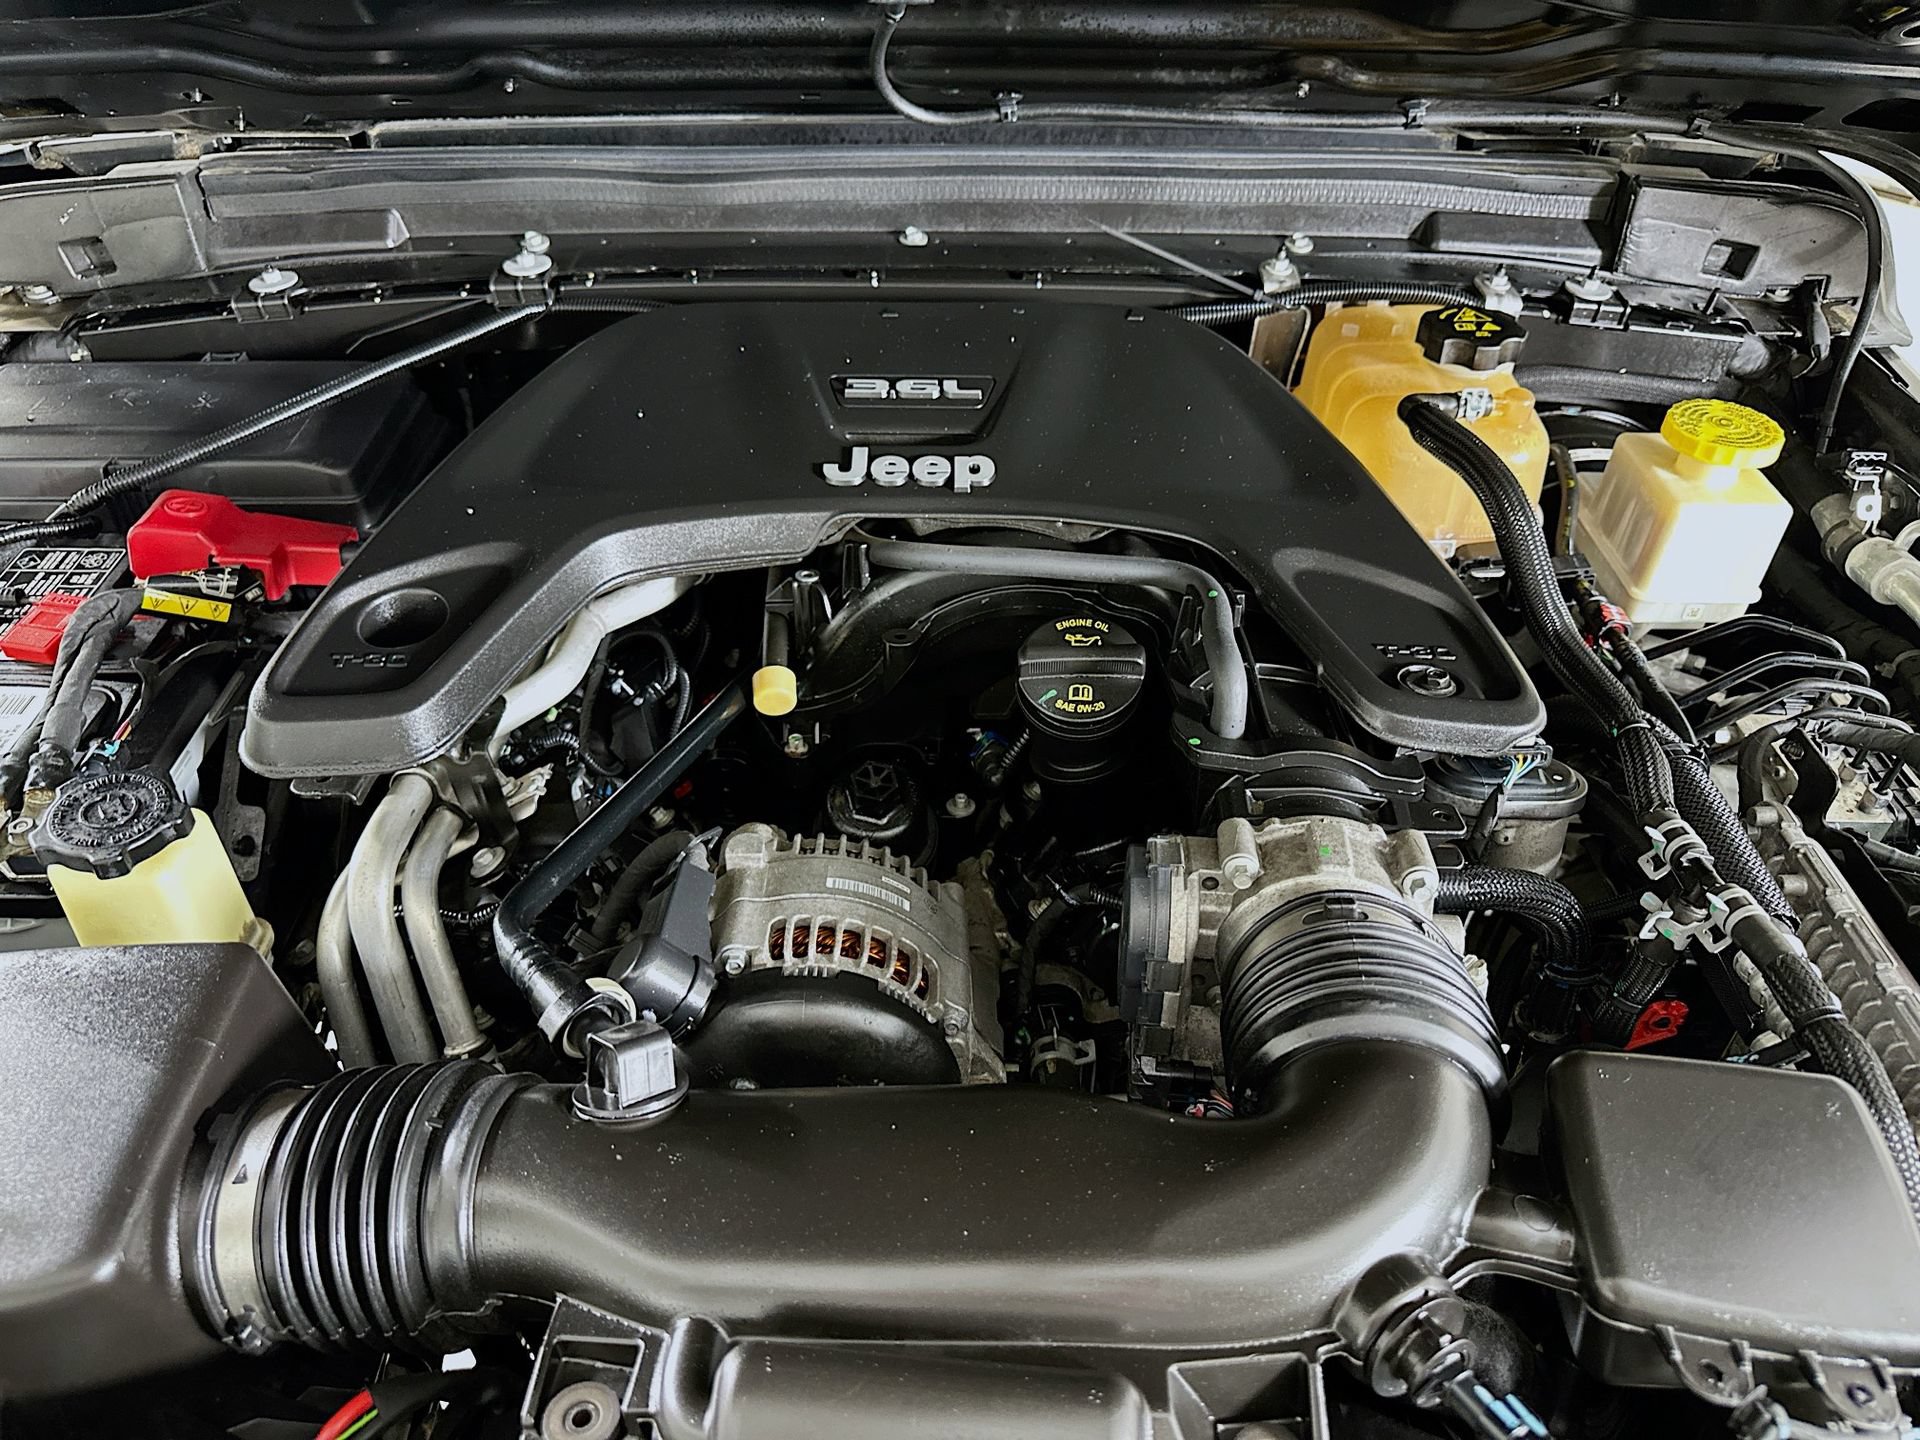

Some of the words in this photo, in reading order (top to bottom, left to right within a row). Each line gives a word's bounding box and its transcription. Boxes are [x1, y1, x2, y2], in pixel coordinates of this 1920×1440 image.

[844, 378, 984, 399] 3.6L
[822, 446, 997, 494] Jeep
[1055, 618, 1093, 631] ENGINE
[1094, 620, 1110, 632] OIL
[1055, 699, 1075, 712] SAE
[1076, 701, 1105, 713] 0W-20
